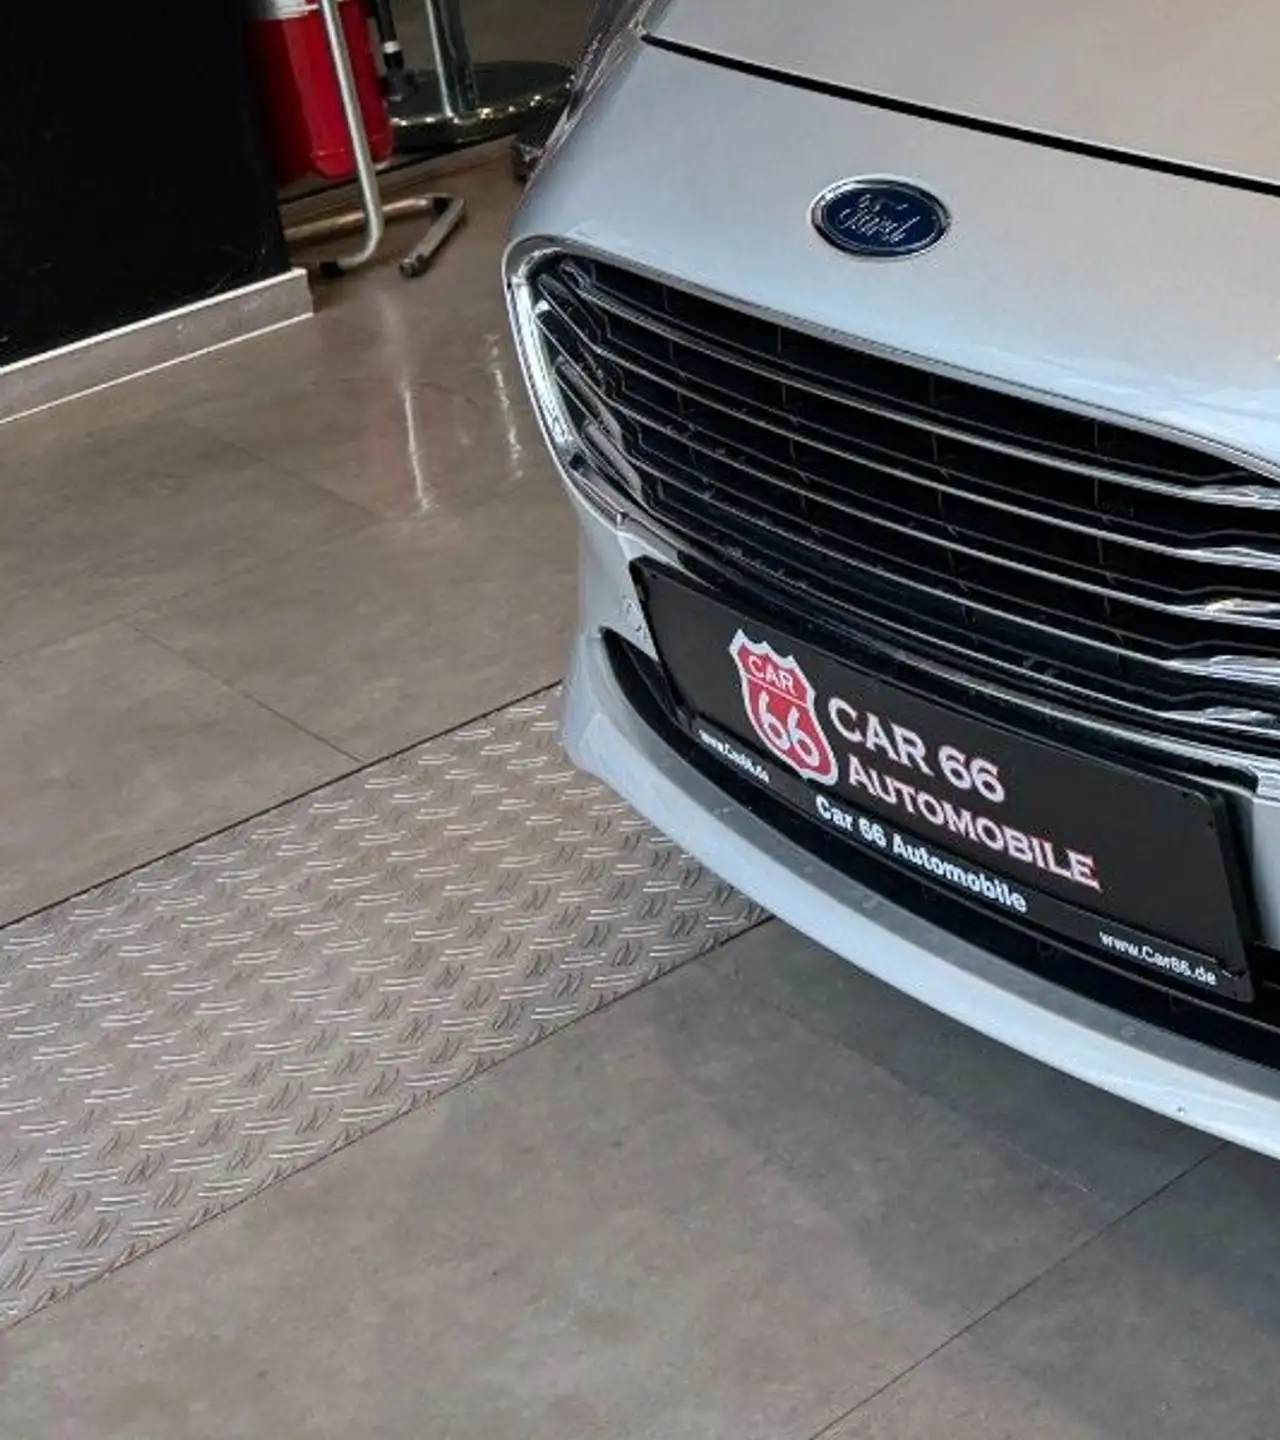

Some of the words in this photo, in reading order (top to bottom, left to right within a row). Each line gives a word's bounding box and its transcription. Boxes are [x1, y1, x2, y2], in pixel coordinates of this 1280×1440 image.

[749, 655, 798, 696] CAR
[759, 691, 820, 767] 66
[828, 698, 934, 777] CAR
[938, 745, 1005, 802] 66
[815, 794, 853, 832] Car
[859, 818, 887, 851] 66
[892, 833, 1027, 913] Automobile
[849, 754, 1101, 892] AUTOMOBILE
